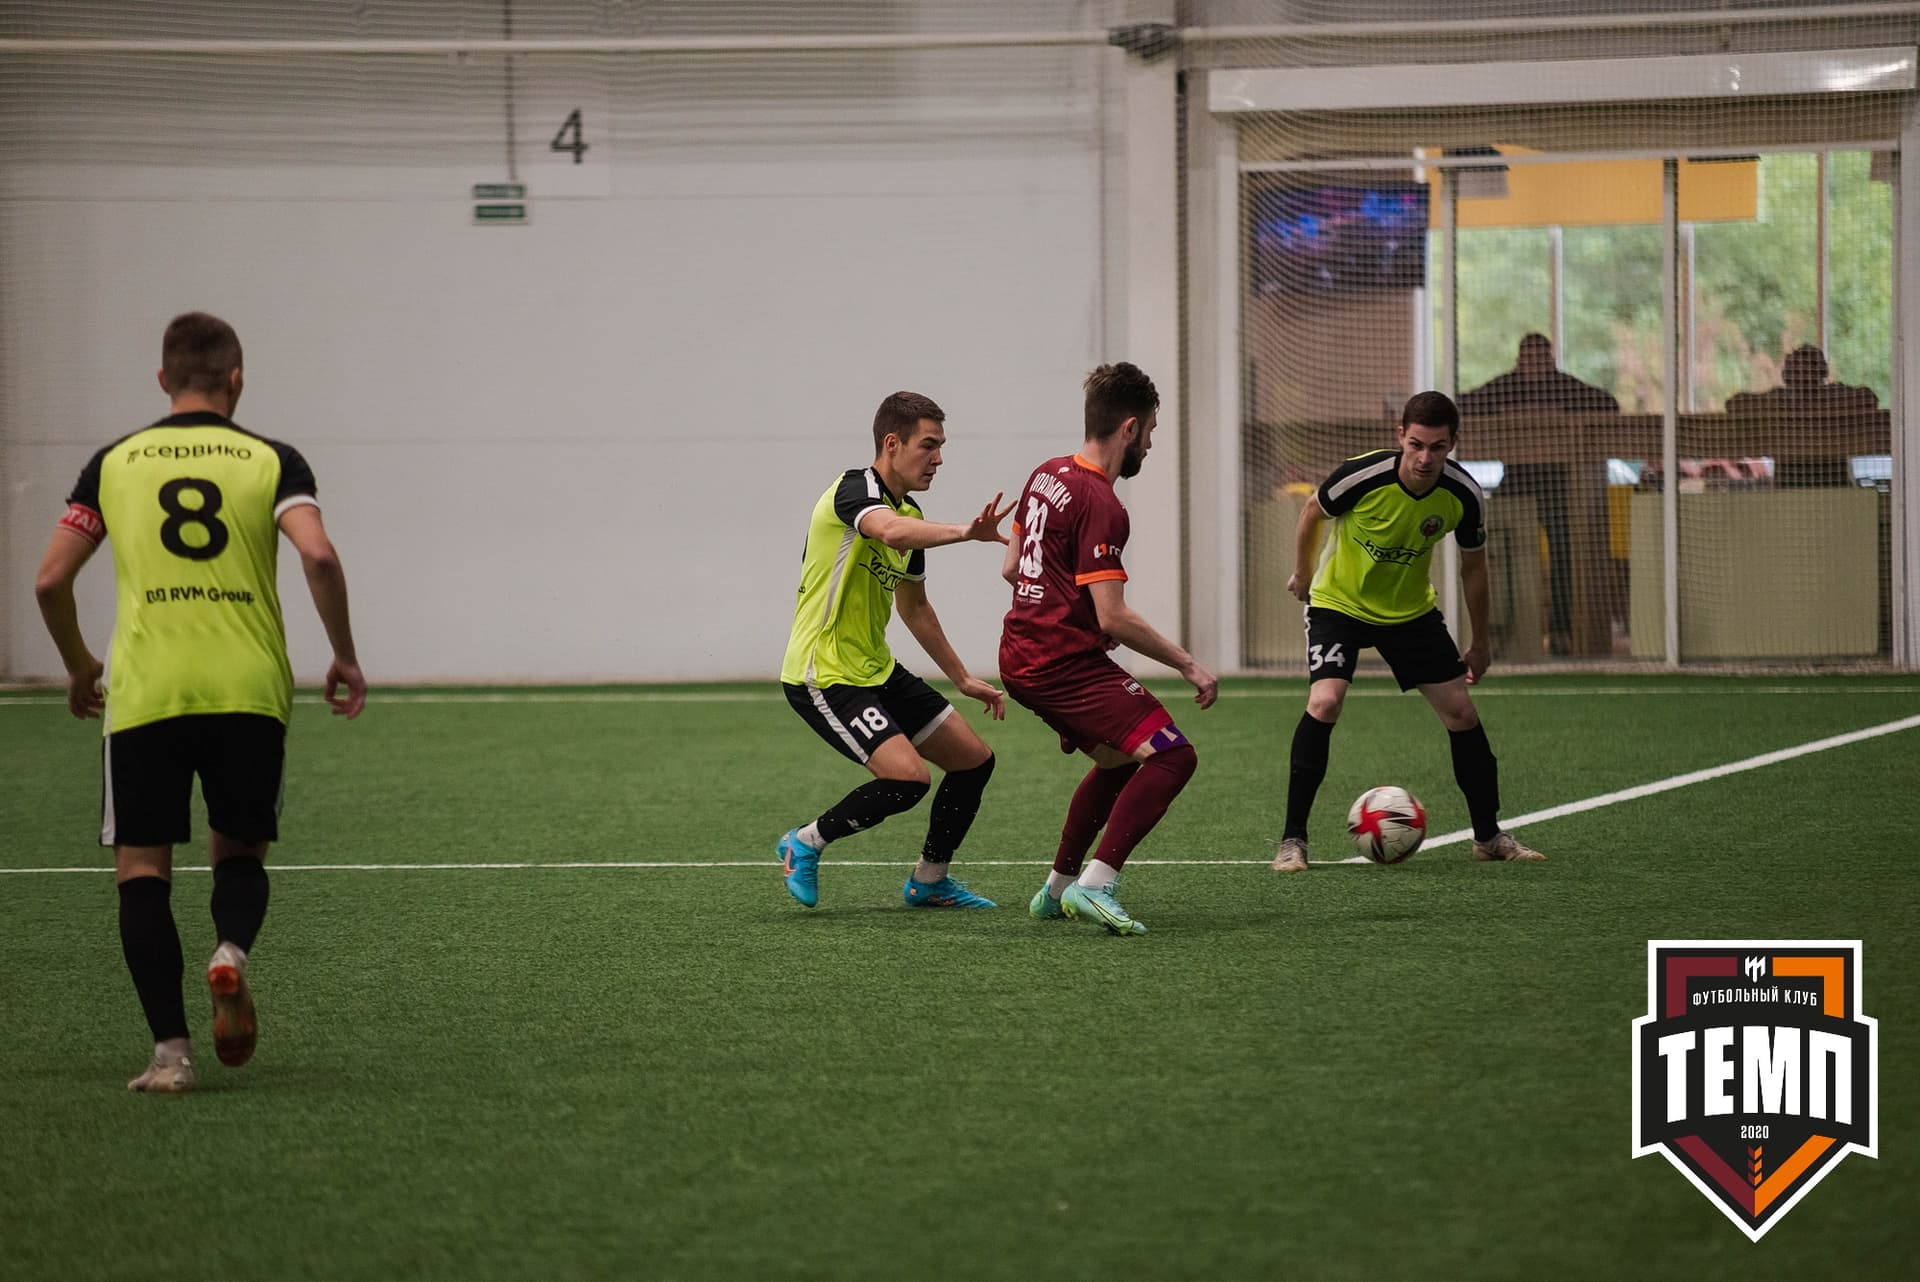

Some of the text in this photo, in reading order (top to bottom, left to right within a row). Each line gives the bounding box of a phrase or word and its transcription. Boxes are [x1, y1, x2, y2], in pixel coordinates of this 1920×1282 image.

[551, 107, 589, 165] 4
[158, 477, 230, 563] 8
[170, 586, 255, 606] RVM Group
[1309, 643, 1346, 671] 34
[850, 706, 889, 740] 18
